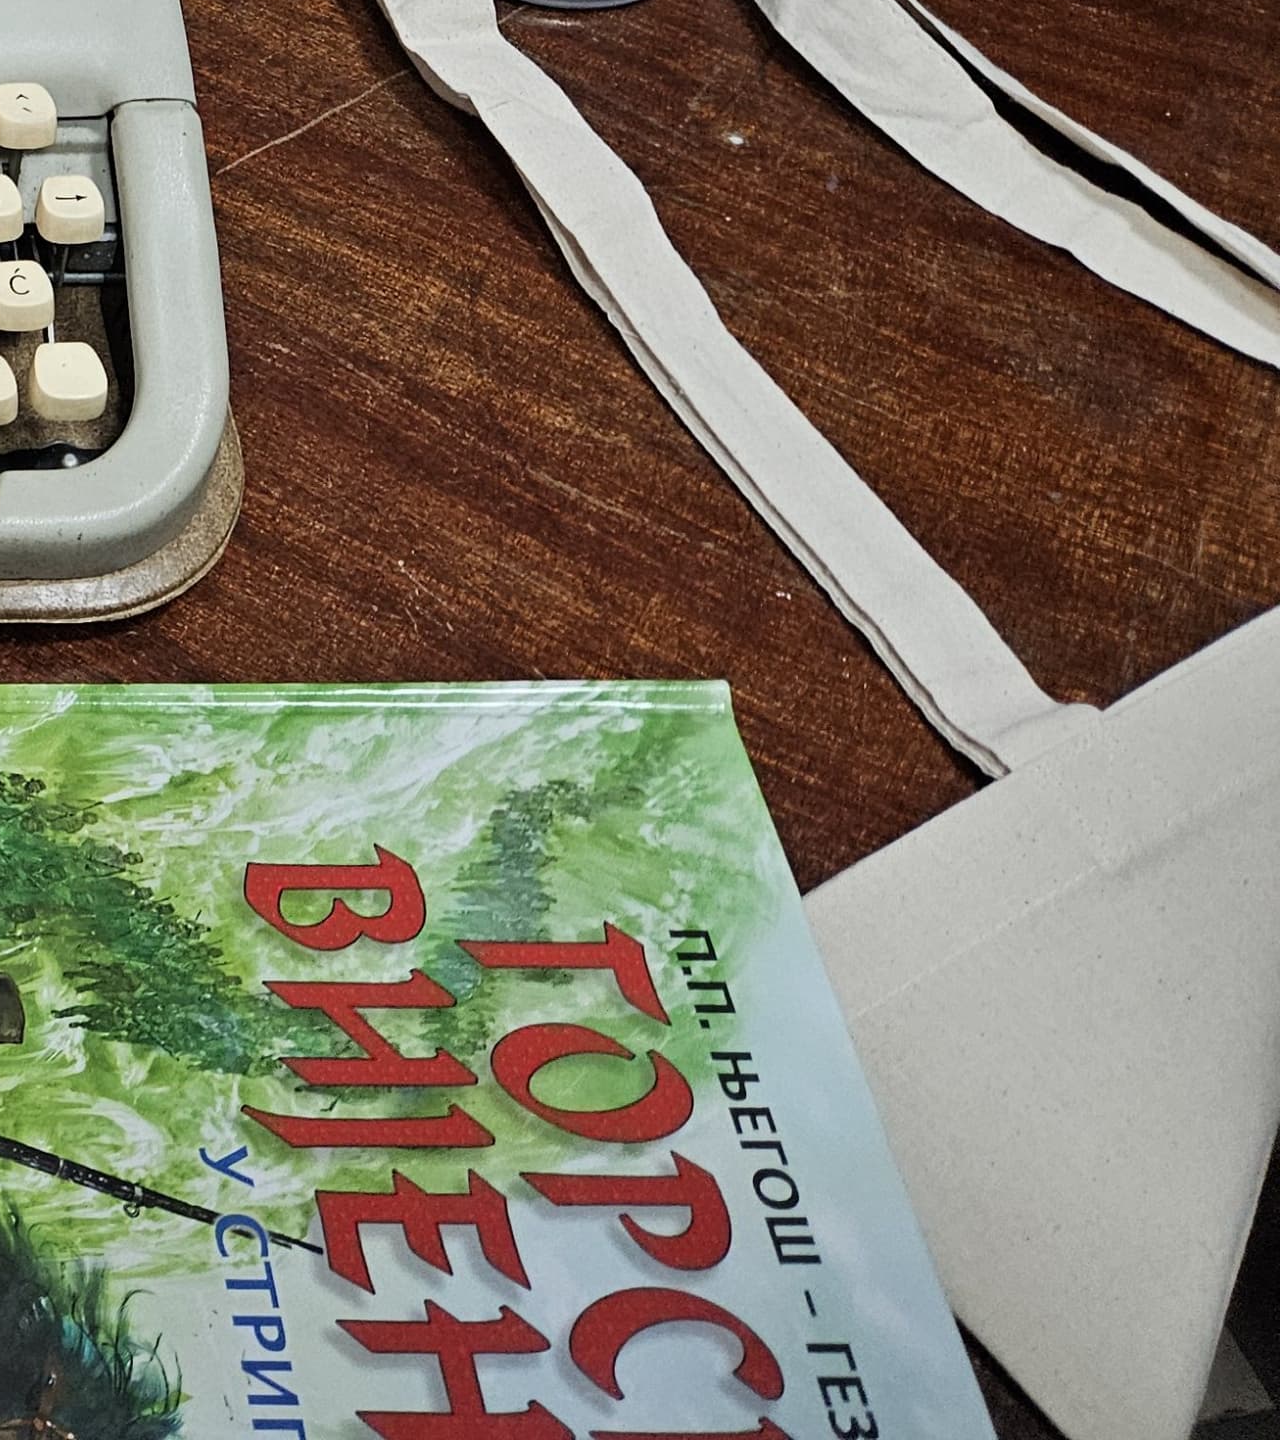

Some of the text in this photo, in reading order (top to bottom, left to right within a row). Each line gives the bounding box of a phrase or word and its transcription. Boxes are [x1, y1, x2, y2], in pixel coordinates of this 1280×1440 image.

[8, 267, 31, 296] Ć
[455, 920, 794, 1440] ГОРС
[669, 927, 738, 1031] П.П.
[710, 1050, 824, 1266] ЊЕГОШ
